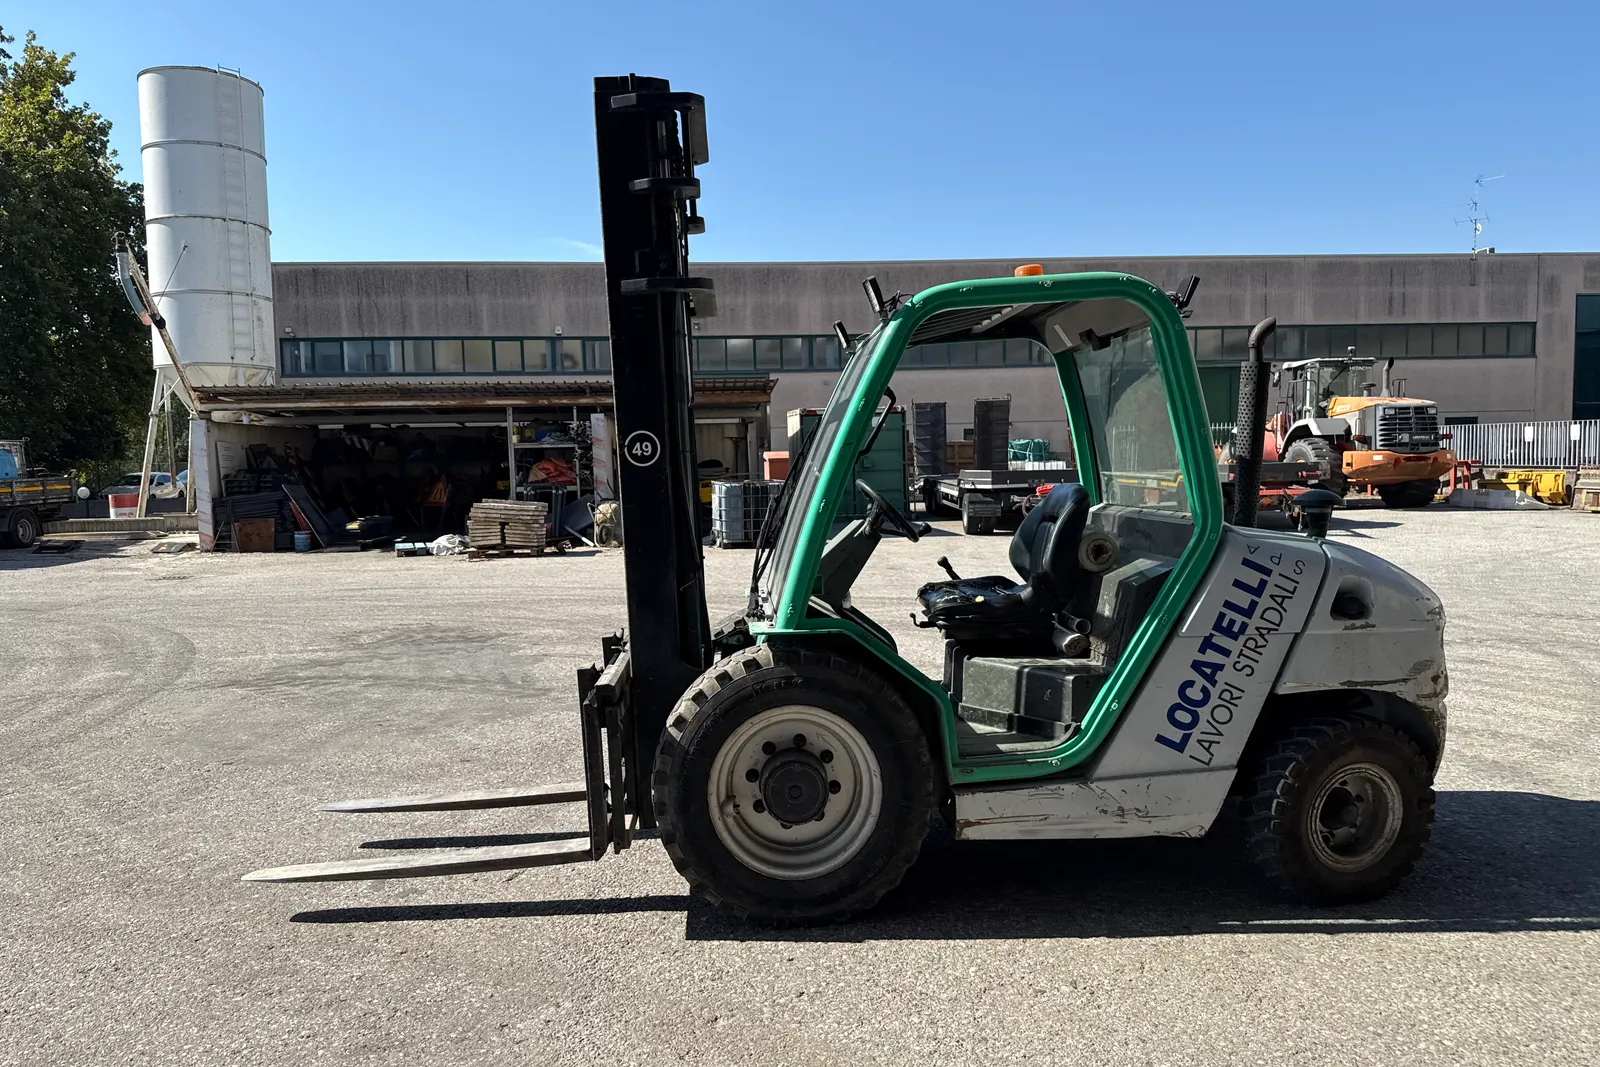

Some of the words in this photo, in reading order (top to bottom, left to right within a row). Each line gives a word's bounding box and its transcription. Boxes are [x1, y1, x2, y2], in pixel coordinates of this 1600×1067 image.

[632, 441, 652, 456] 49
[1154, 556, 1273, 754] LOCATELLI
[1189, 681, 1246, 766] LAVORI
[1233, 572, 1300, 678] STRADALI
